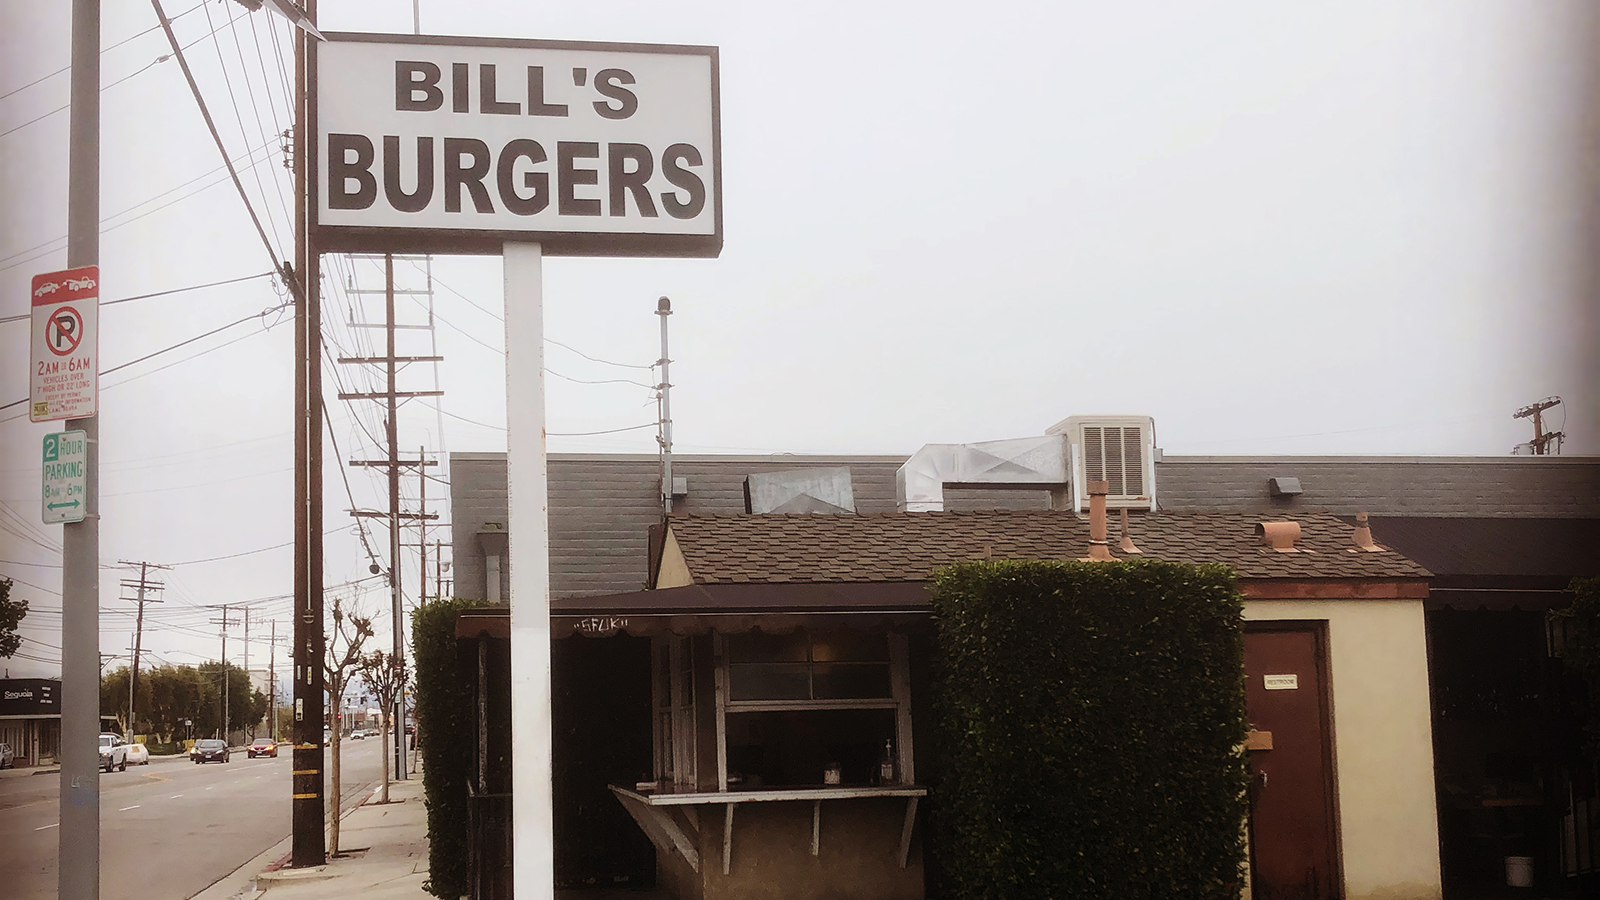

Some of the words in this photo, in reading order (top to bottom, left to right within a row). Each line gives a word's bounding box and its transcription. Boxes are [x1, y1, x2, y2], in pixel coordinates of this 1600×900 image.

[395, 60, 639, 120] BILL'S
[327, 132, 707, 220] BURGERS
[38, 361, 59, 376] 2AM
[69, 357, 89, 371] 6AM
[43, 375, 68, 384] VEHICLES
[70, 372, 84, 381] OVER
[57, 383, 65, 392] OR
[46, 439, 55, 457] 2
[60, 441, 82, 455] HOUR
[45, 461, 82, 480] PARKING
